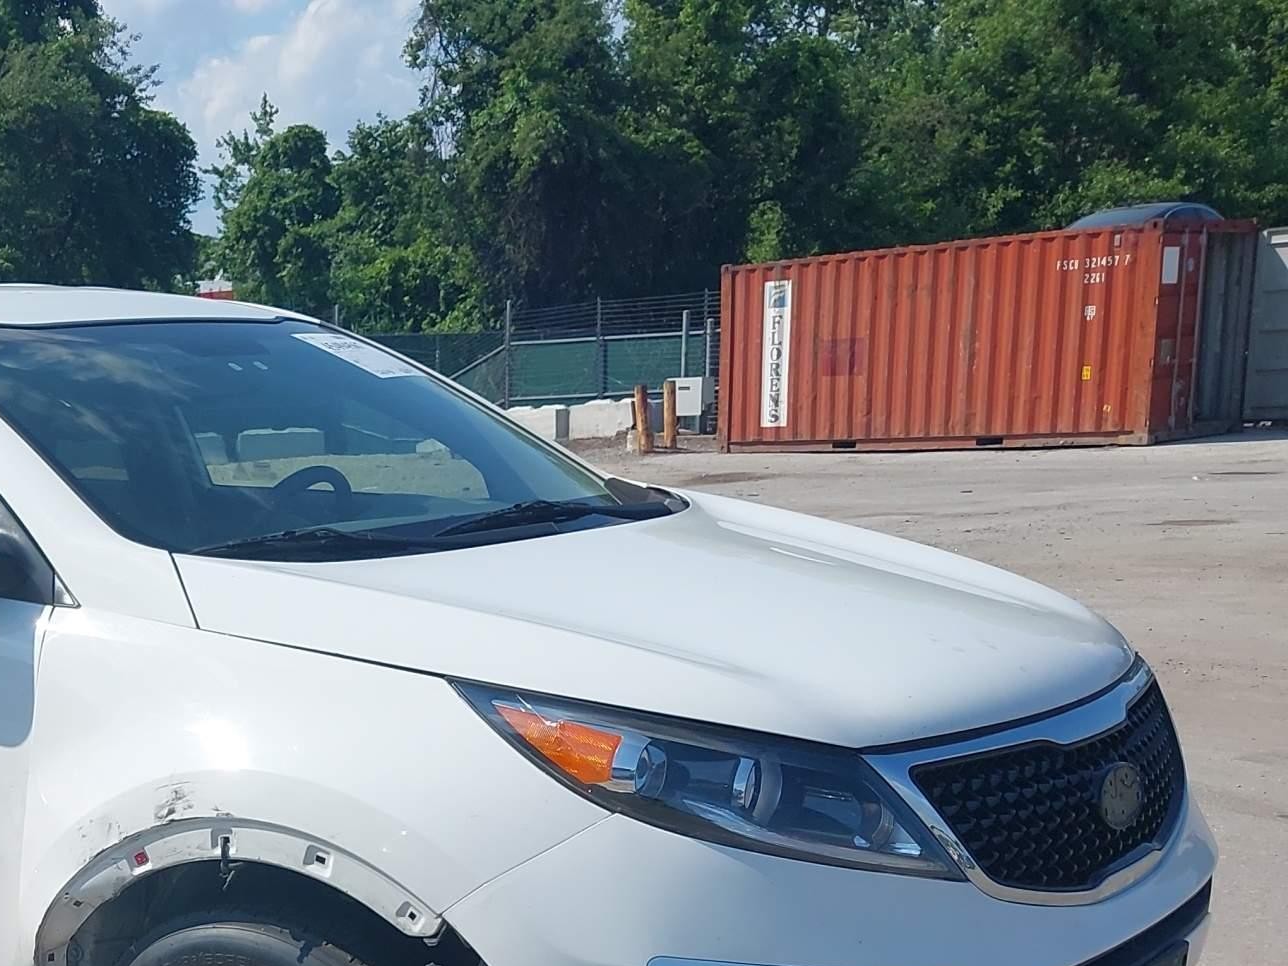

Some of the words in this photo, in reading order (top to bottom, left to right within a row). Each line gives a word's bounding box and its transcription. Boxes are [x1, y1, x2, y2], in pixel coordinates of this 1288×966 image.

[1085, 255, 1120, 268] 321457
[1124, 254, 1131, 266] 7
[768, 315, 782, 423] FLORENS
